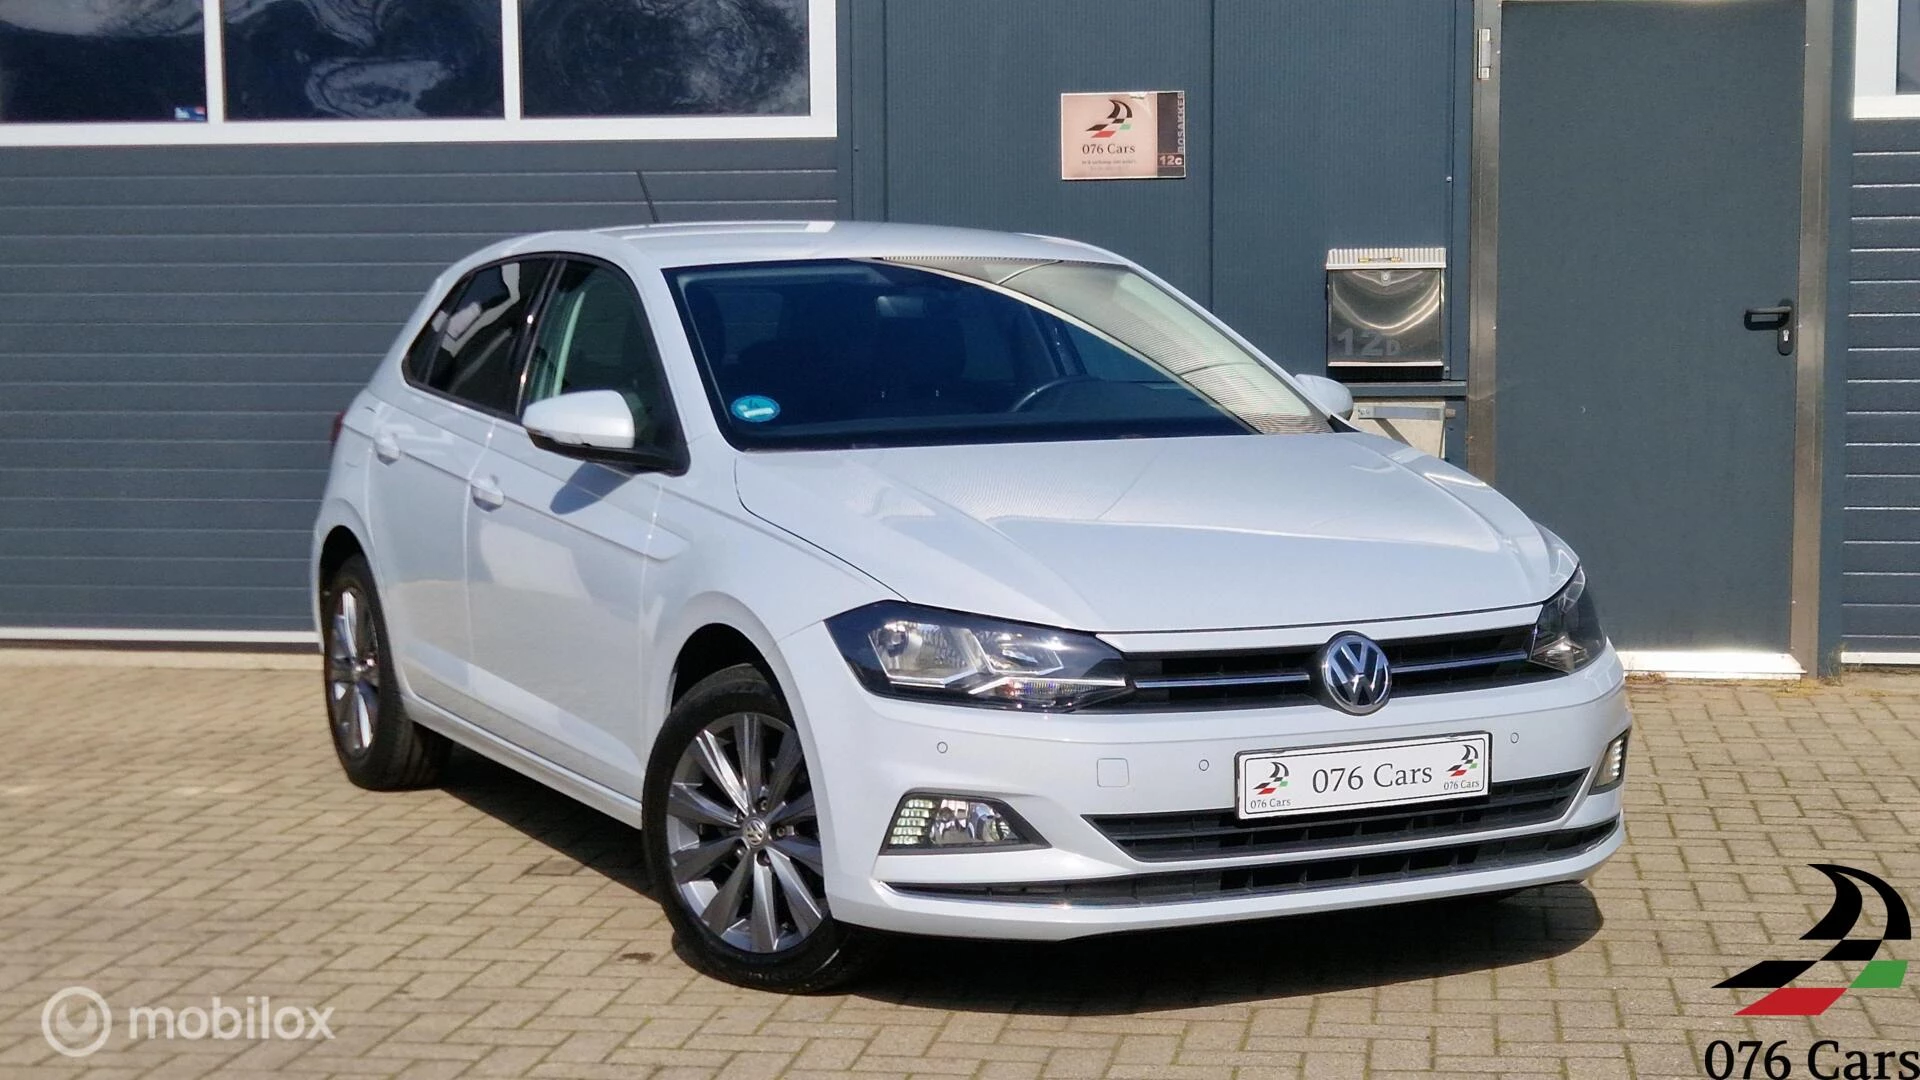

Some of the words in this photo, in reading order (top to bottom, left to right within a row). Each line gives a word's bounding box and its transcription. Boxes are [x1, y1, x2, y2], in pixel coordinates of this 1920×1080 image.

[1082, 144, 1103, 154] 076
[1107, 143, 1136, 154] Cars
[1312, 766, 1364, 794] 076
[1373, 763, 1433, 788] Cars
[1442, 780, 1459, 791] 076
[1460, 779, 1480, 789] Cars
[1250, 799, 1267, 809] 076
[1269, 797, 1291, 808] Cars
